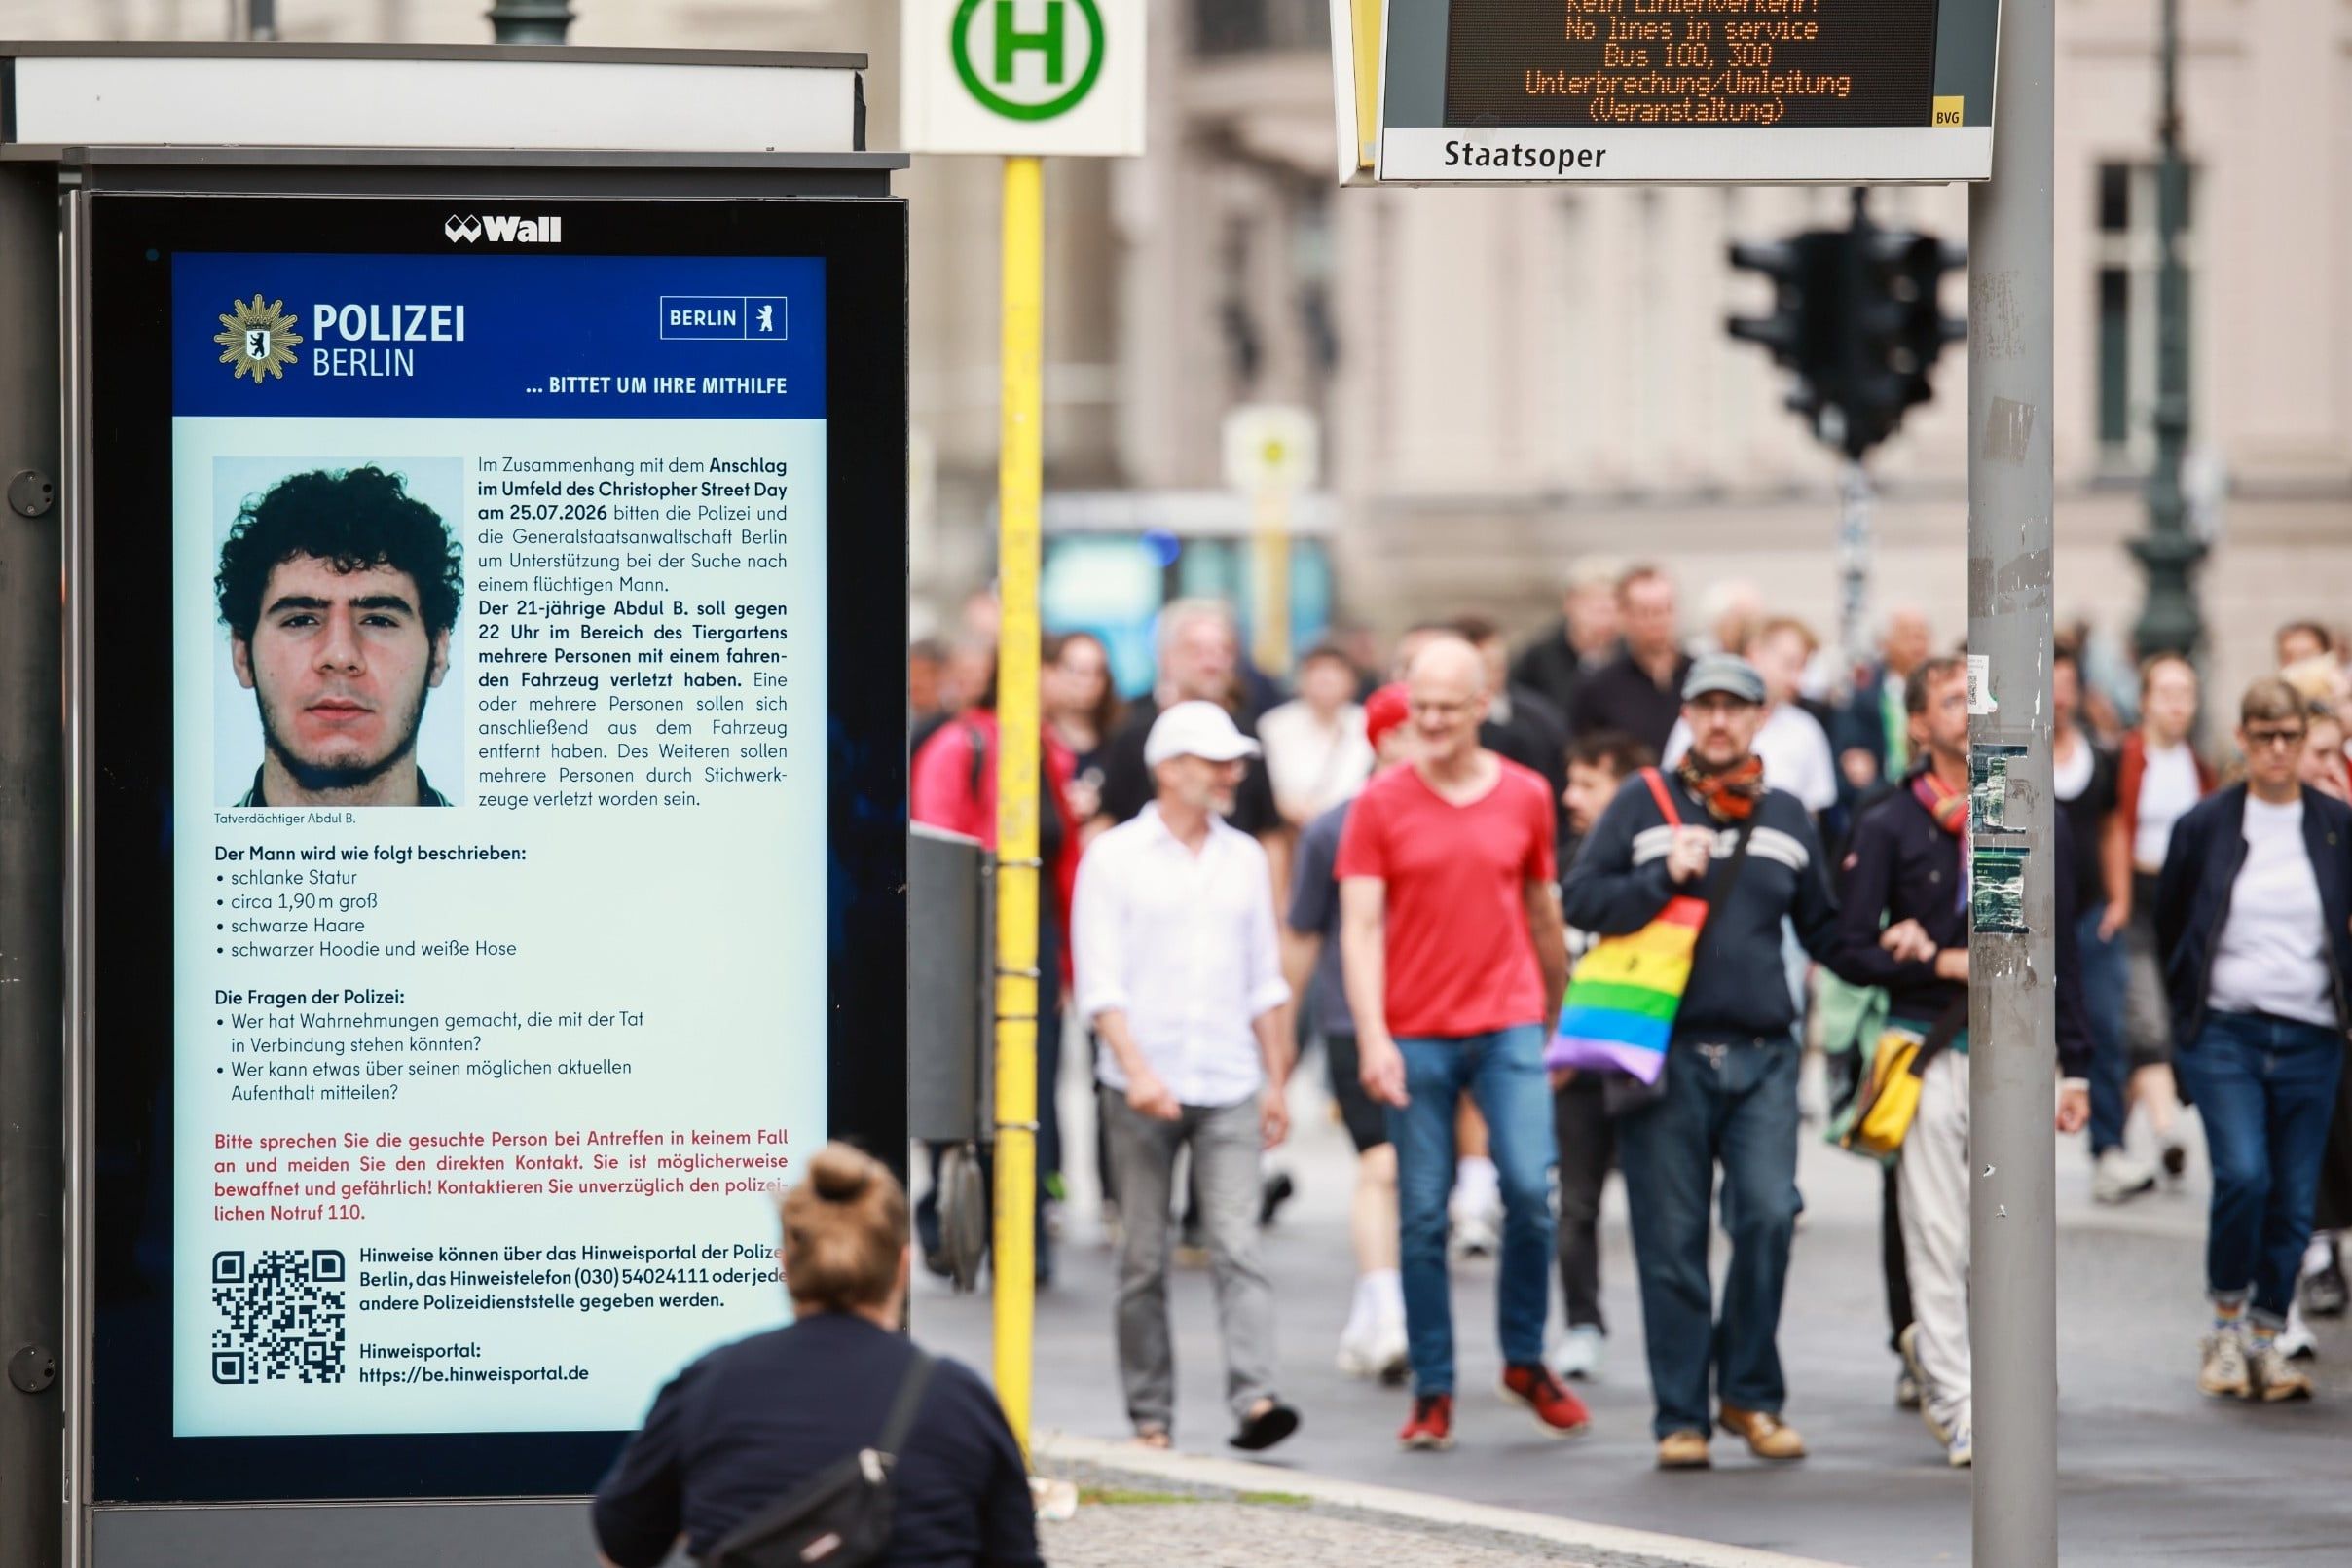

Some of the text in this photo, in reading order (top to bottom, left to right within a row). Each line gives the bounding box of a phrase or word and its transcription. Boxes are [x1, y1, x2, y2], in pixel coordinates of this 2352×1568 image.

[1565, 16, 1819, 40] No lines in service
[995, 0, 1064, 84] H
[1604, 43, 1773, 70] Bus 100, 300
[1525, 69, 1851, 97] Unterbrechung/Umleitung
[1590, 97, 1783, 125] (Veranstaltung)
[1936, 111, 1960, 125] BVG
[1444, 140, 1607, 175] Staatsoper
[481, 215, 562, 243] Wall
[313, 303, 465, 342] POLIZEI
[670, 310, 737, 326] BERLIN
[313, 347, 414, 377] BERLIN
[549, 376, 611, 394] BITTET
[616, 376, 647, 394] UM
[653, 377, 697, 394] IHRE
[702, 377, 788, 394] MITHILFE
[478, 456, 788, 478] Im Zusammenhang mit dem Anschlag
[478, 480, 788, 501] im Umfeld des Christopher Street Day
[477, 504, 787, 521] am 25.07.2026 bitten die Polizei und
[477, 528, 788, 545] die Generalstaatsanwaltschaft Berlin
[478, 575, 669, 596] einem flüchtigen Mann.
[479, 600, 788, 620] Der 21-jährige Abdul B. soll gegen
[478, 646, 788, 664] mehrere Personen mit einem fahren-
[478, 694, 788, 711] oder mehrere Personen sollen sich
[478, 718, 788, 739] anschließend aus dem Fahrzeug
[479, 766, 788, 784] mehrere Personen durch Stichwerk-
[478, 789, 700, 811] zeuge verletzt worden sein.
[213, 812, 356, 827] Tatverdächtiger Abdul B.
[214, 844, 527, 865] Der Mann wird wie folgt beschrieben:
[231, 868, 358, 886] schlanke Statur
[231, 917, 365, 933] schwarze Haare
[231, 939, 517, 958] schwarzer Hoodie und weiße Hose
[215, 988, 405, 1009] Die Fragen der Polizei:
[231, 1010, 644, 1032] Wer hat Wahrnehmungen gemacht, die mit der Tat
[231, 1035, 482, 1057] in Verbindung stehen könnten?
[231, 1083, 398, 1102] Aufenthalt mitteilen?
[214, 1128, 789, 1152] Bitte sprechen Sie die gesuchte Person bei Antreffen in keinem Fall
[214, 1180, 300, 1198] bewaffnet
[304, 1180, 336, 1197] und
[341, 1179, 432, 1200] gefährlich!
[437, 1178, 543, 1195] Kontaktieren
[548, 1178, 574, 1194] Sie
[578, 1177, 685, 1197] unverzüglich
[689, 1177, 720, 1193] den
[214, 1203, 366, 1222] lichen Notruf 110.
[359, 1243, 782, 1264] Hinweise können über das Hinweisportal der Polize
[359, 1270, 414, 1290] Berlin,
[415, 1270, 447, 1287] das
[450, 1268, 571, 1286] Hinweistelefon
[574, 1266, 619, 1289] (030)
[622, 1267, 710, 1285] 54024111
[713, 1267, 750, 1284] oder
[358, 1291, 725, 1313] andere Polizeidienststelle gegeben werden.
[359, 1341, 481, 1363] Hinweisportal:
[359, 1364, 590, 1387] https://be.hinweisportal.de
